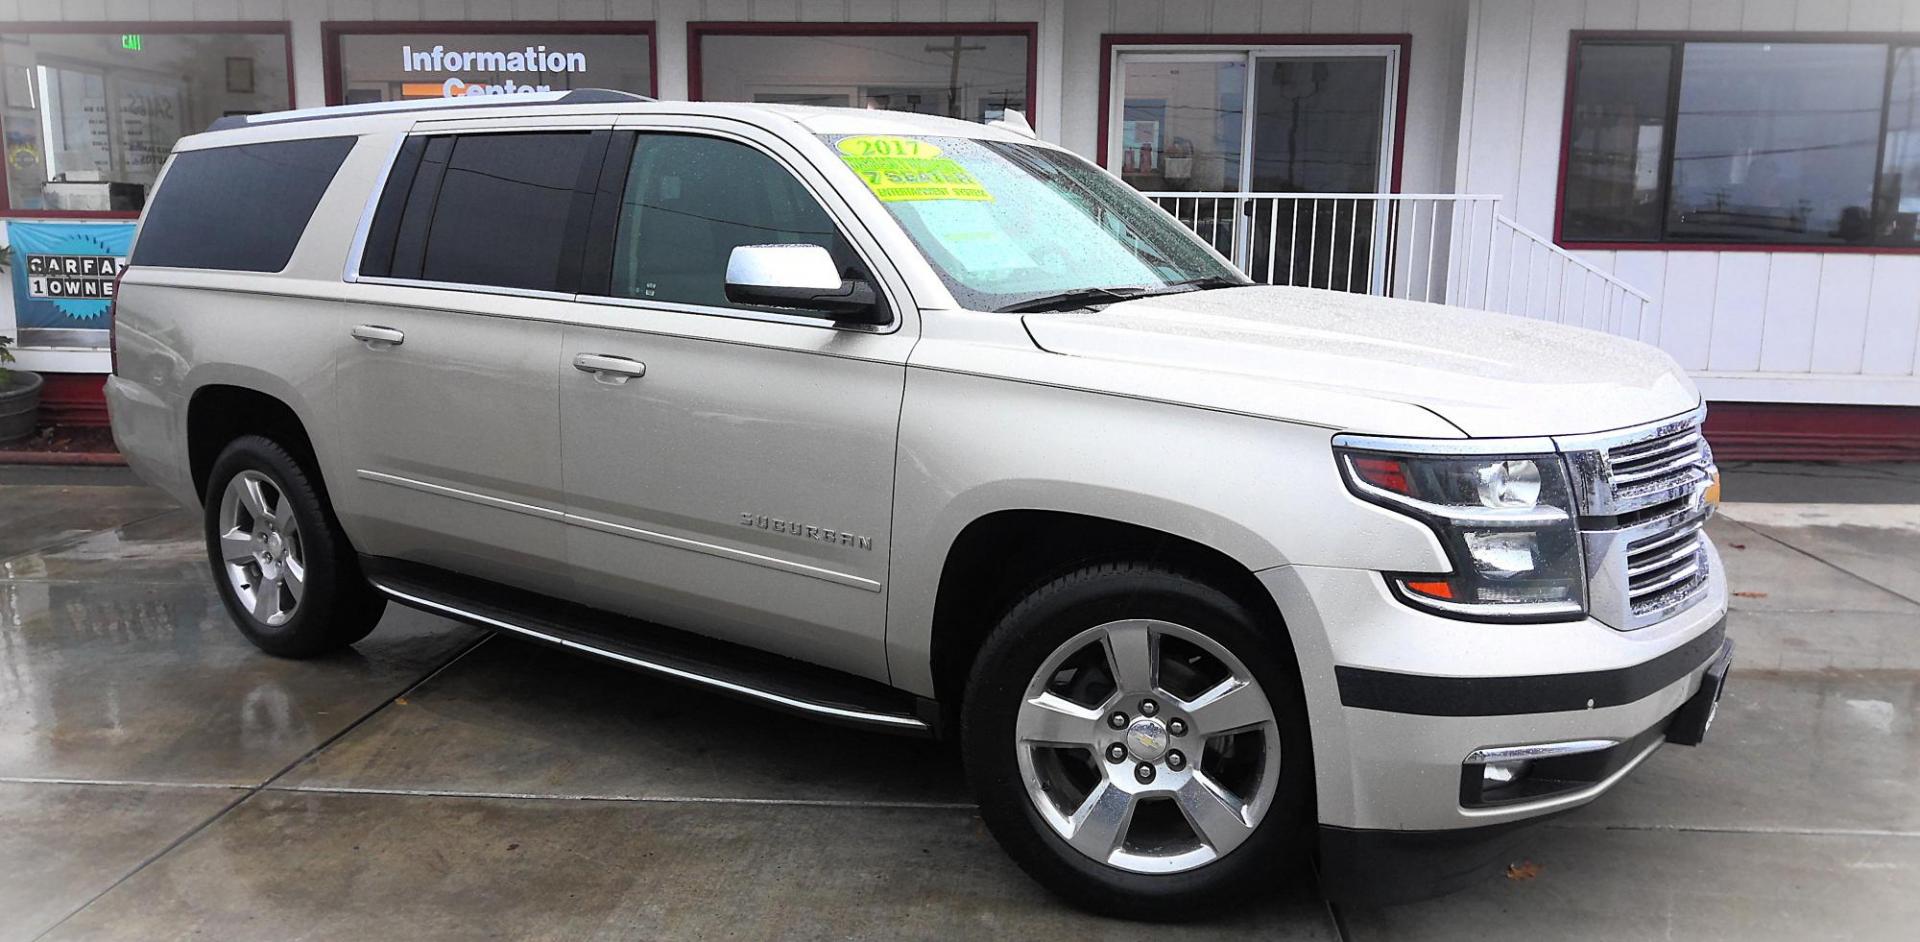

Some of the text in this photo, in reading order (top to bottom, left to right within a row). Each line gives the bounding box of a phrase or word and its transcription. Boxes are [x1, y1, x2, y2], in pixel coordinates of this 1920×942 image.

[402, 45, 586, 72] Information
[857, 139, 919, 156] 2017
[863, 170, 881, 184] 7
[33, 280, 113, 295] 1 OWNE
[740, 512, 872, 551] SUBURBAN
